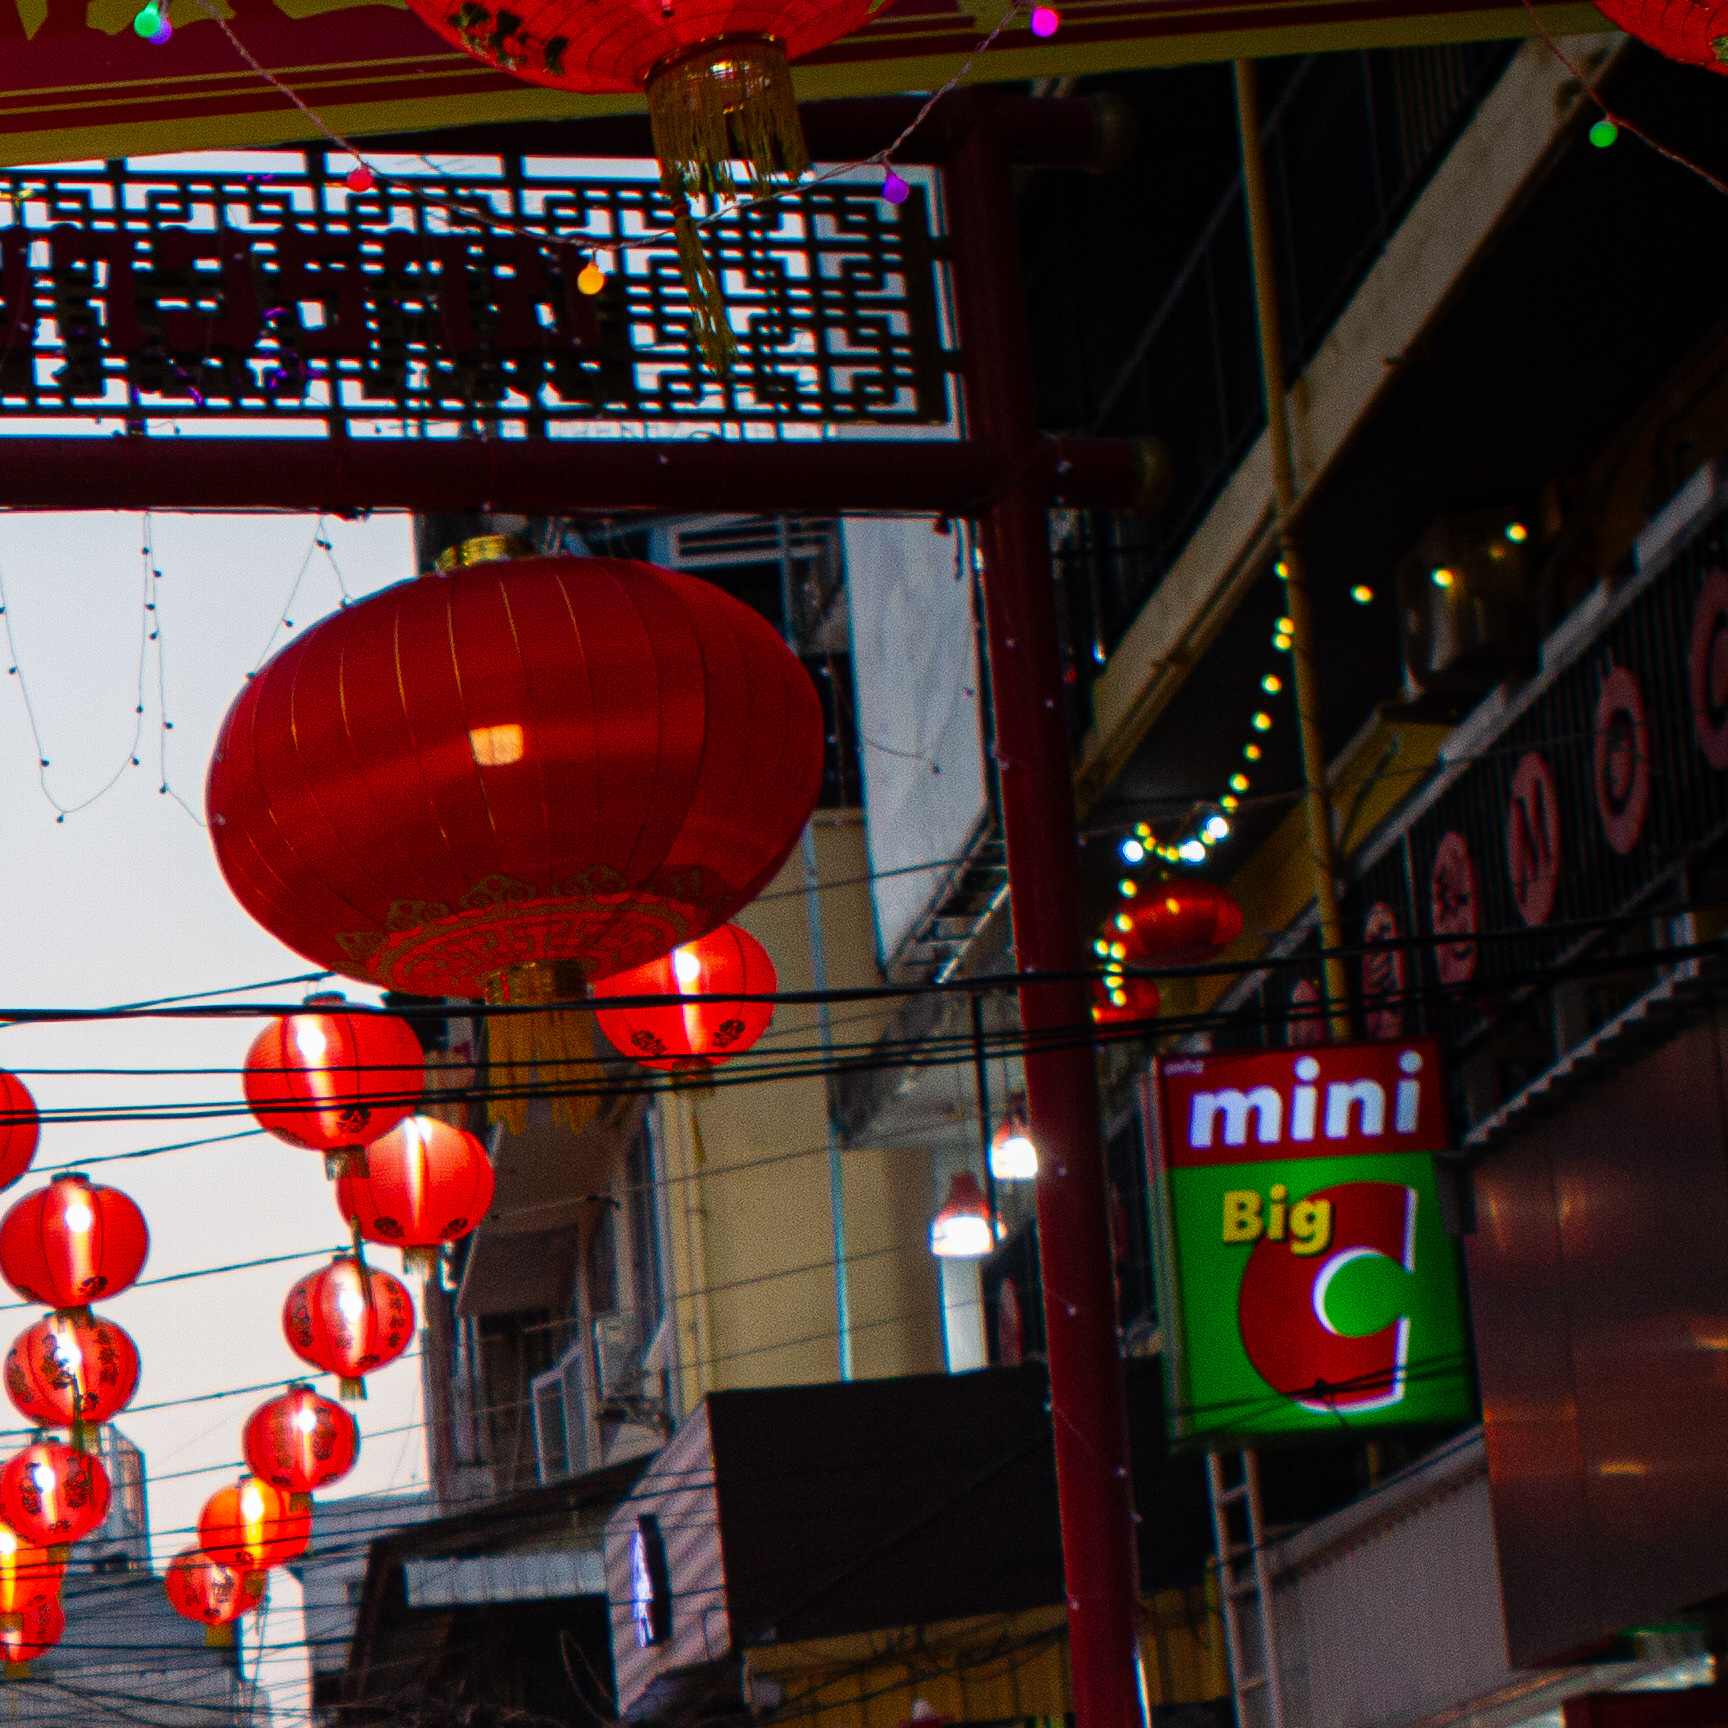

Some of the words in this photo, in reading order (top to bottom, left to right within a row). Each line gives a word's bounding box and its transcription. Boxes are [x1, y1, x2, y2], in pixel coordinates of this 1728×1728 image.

[1188, 1049, 1424, 1150] mini
[1222, 1183, 1333, 1257] Big
[1238, 1180, 1420, 1416] C
